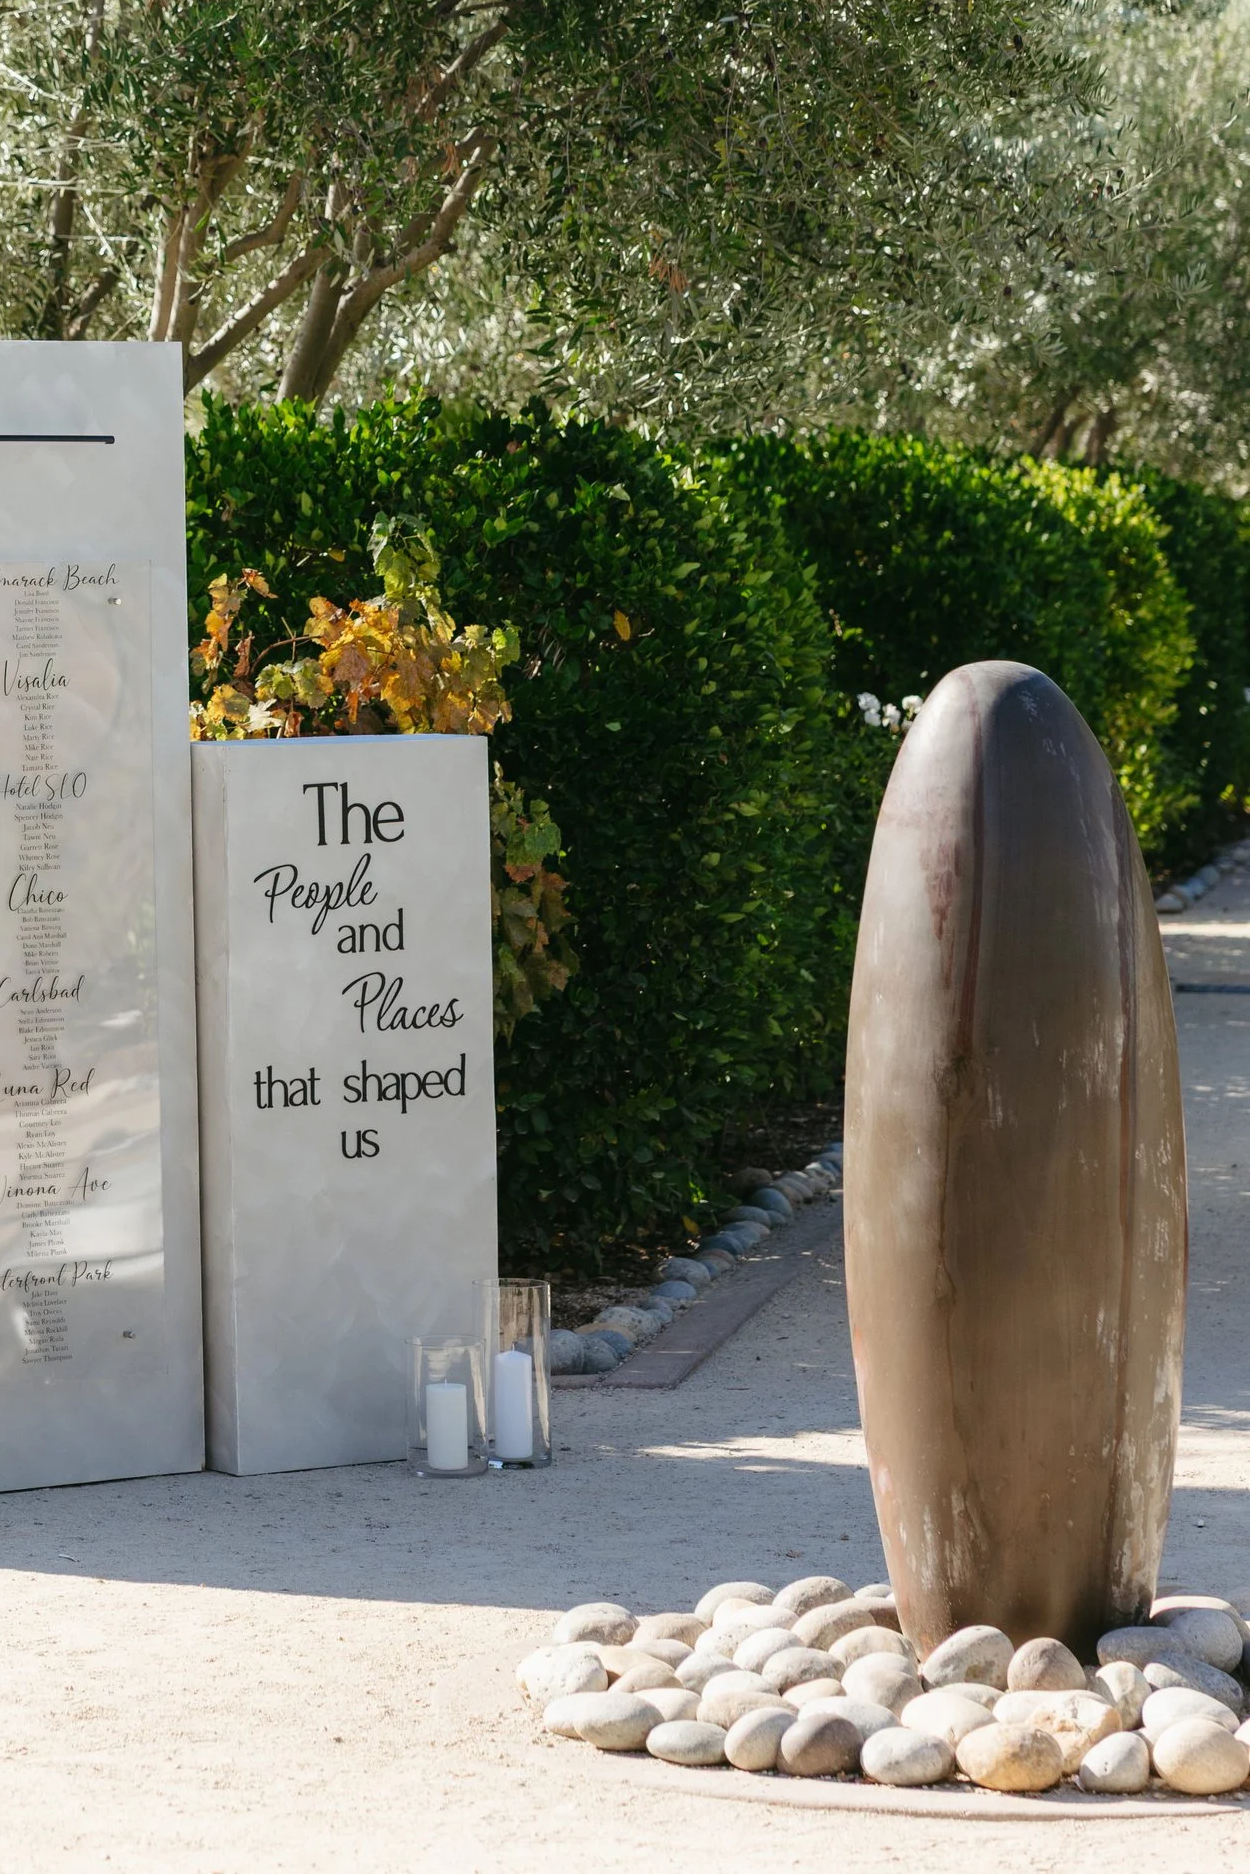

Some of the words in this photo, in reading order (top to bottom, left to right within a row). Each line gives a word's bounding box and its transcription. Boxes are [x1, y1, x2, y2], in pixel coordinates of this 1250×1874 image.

[63, 563, 119, 591] Beach
[4, 658, 70, 696] Visalia
[45, 772, 87, 801] SLO
[302, 782, 404, 846] The
[8, 873, 69, 911] Chico
[254, 854, 378, 935] People
[336, 907, 404, 954] and
[342, 972, 463, 1034] Places
[52, 1068, 95, 1099] Red
[255, 1066, 320, 1109] that
[343, 1053, 466, 1114] shaped
[341, 1126, 380, 1158] us
[66, 1167, 111, 1201] Ave
[72, 1260, 113, 1287] Park
